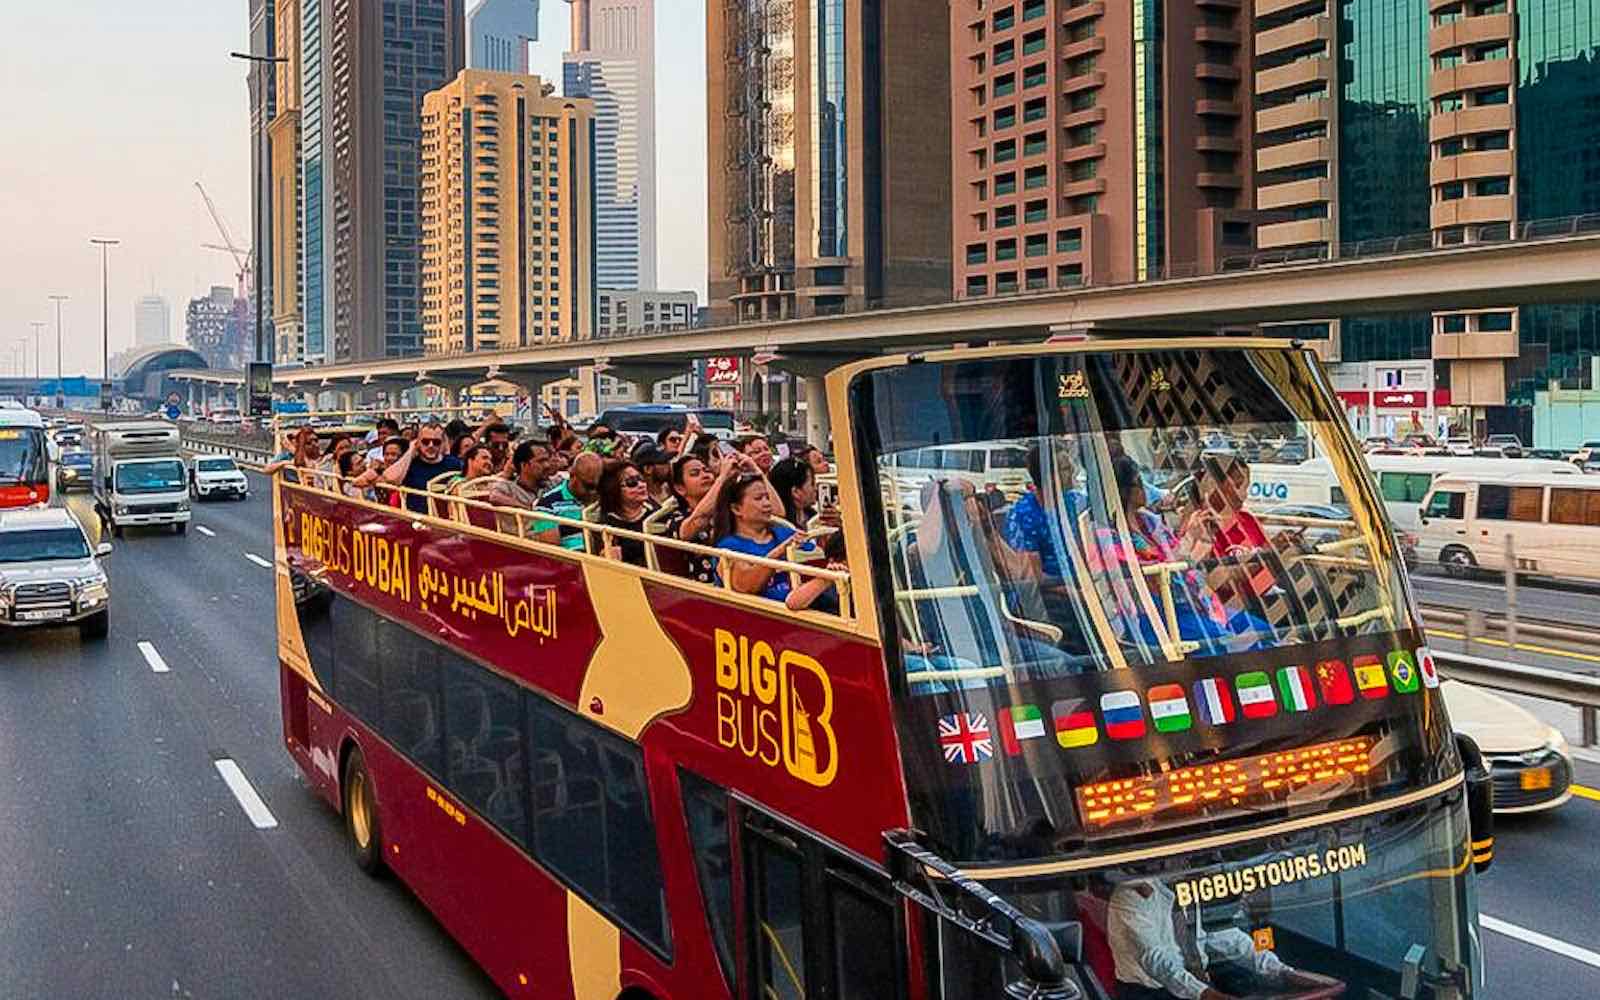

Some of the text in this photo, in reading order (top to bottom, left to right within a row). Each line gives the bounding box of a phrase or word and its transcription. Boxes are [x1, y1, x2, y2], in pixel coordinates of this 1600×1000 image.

[352, 529, 411, 603] DUBAI
[418, 563, 450, 612] دبي
[451, 571, 504, 621] الكبير
[714, 628, 777, 705] BIG
[717, 691, 780, 767] BUS
[1176, 843, 1367, 907] BIGBUSTOURS.COM
